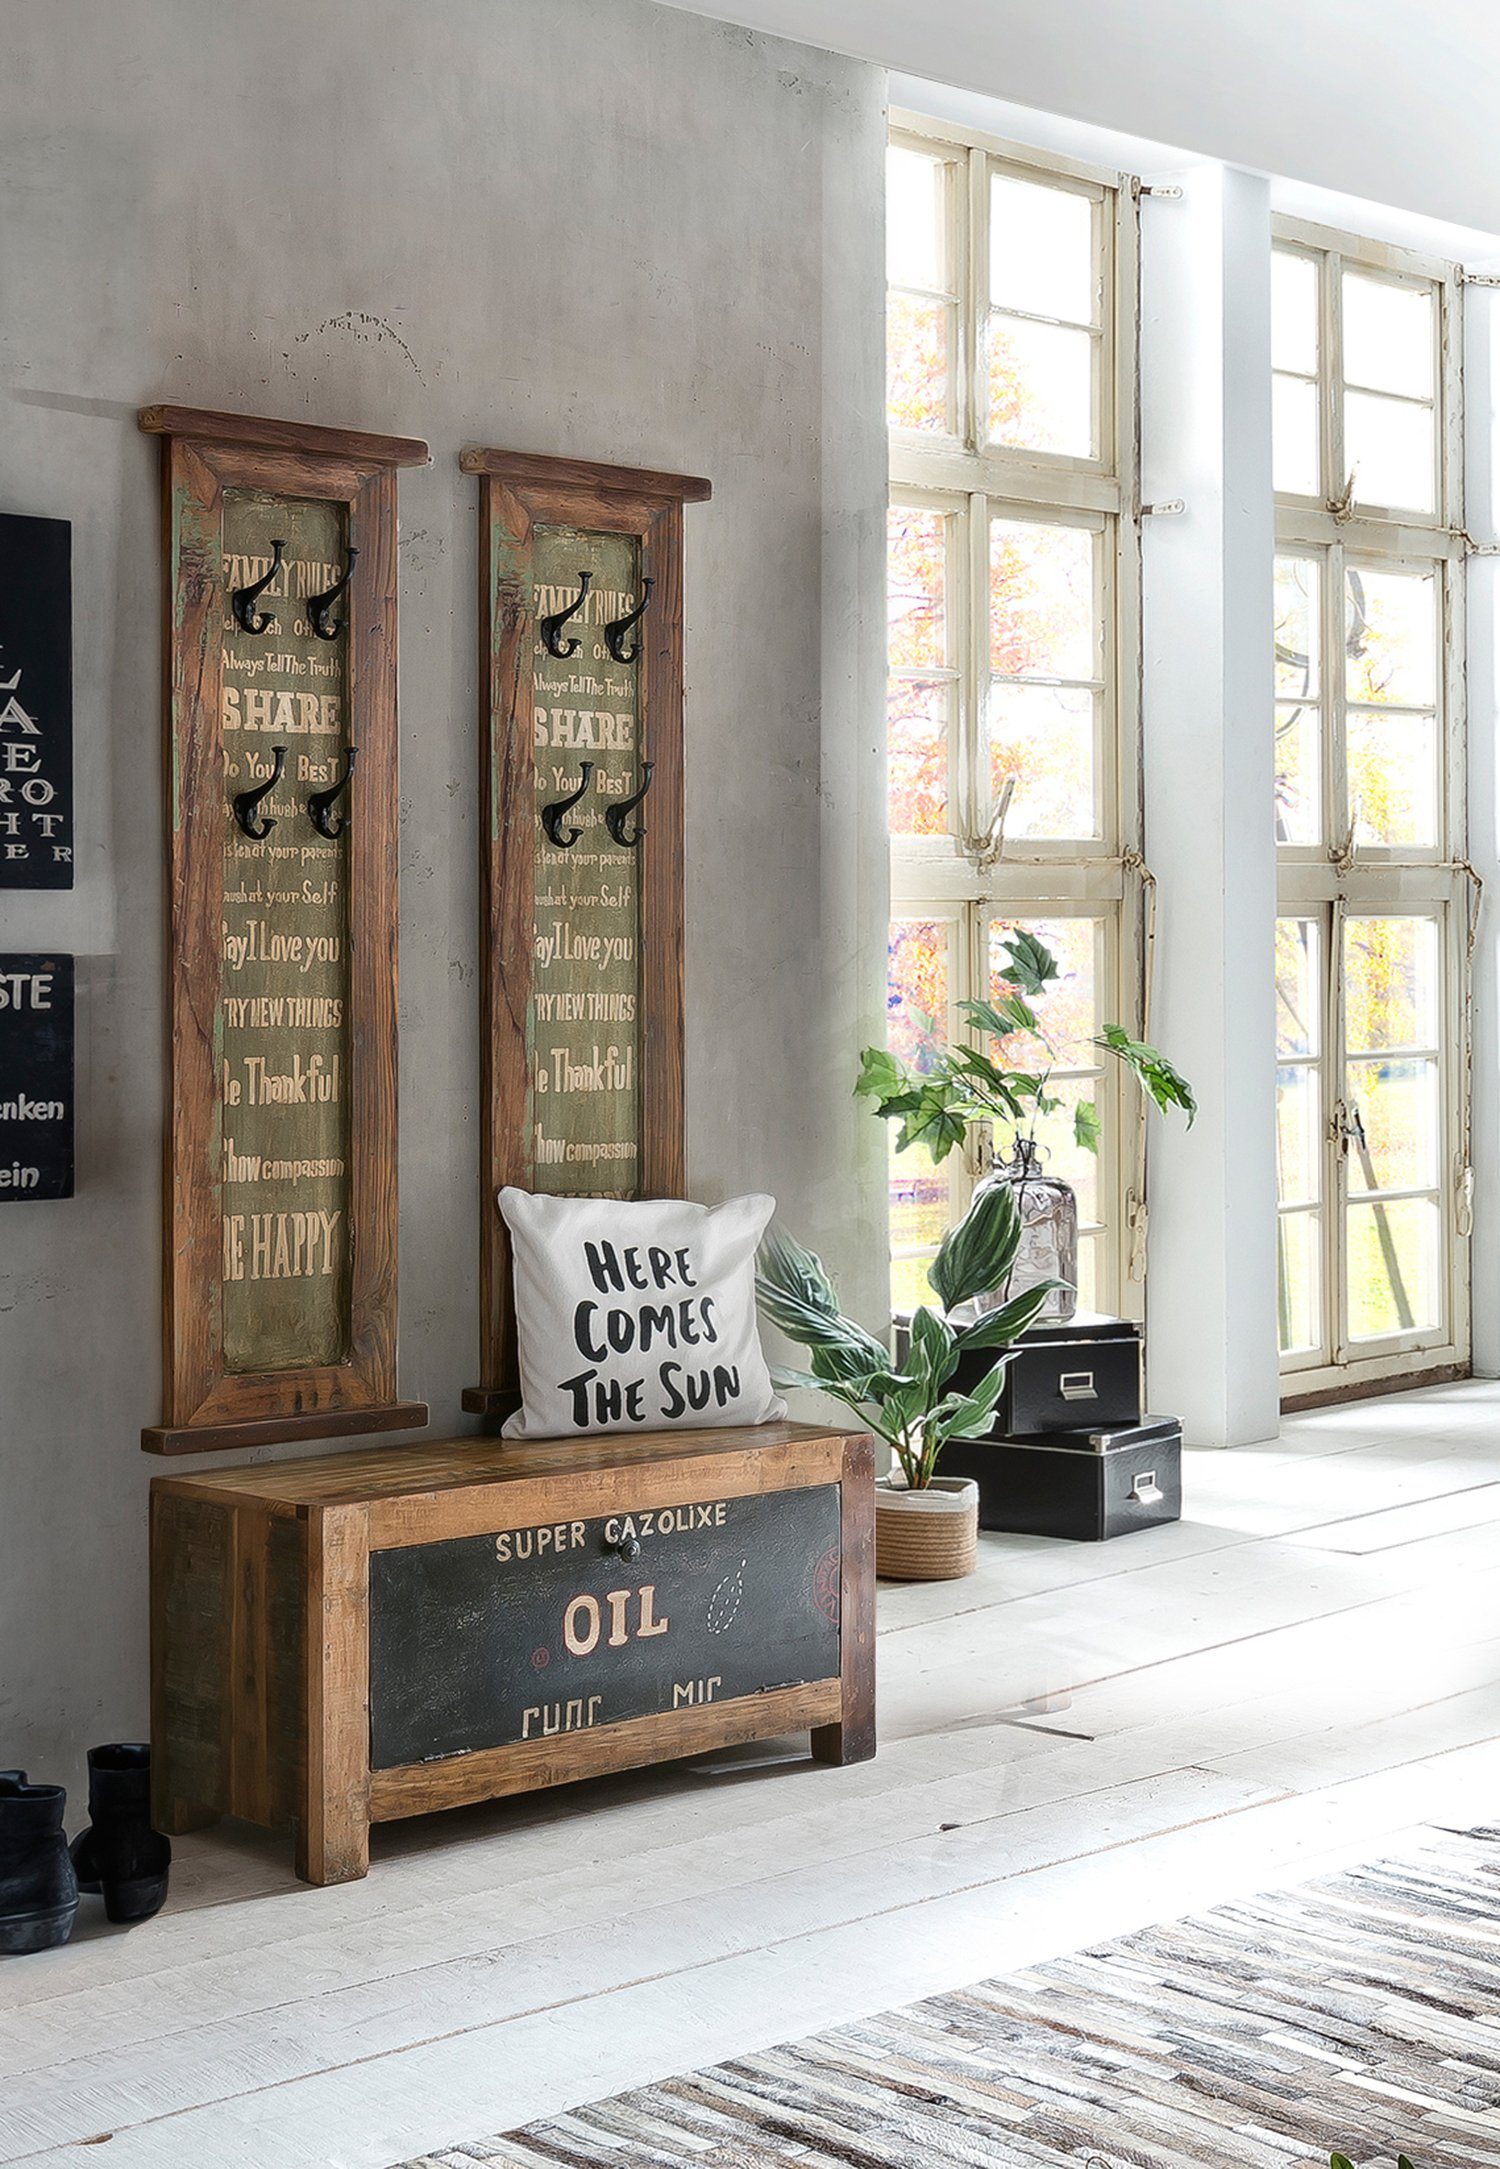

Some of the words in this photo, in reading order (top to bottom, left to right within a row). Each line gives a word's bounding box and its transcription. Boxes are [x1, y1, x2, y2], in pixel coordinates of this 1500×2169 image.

[223, 687, 341, 734] SHARE
[534, 707, 633, 750] SHARE
[302, 879, 338, 904] Self
[601, 884, 631, 907] Self
[261, 921, 301, 962] Love
[300, 937, 339, 972] you
[534, 923, 553, 968] ay
[565, 922, 600, 960] Love
[598, 937, 632, 971] you
[251, 998, 283, 1027] NEW
[287, 998, 343, 1028] THINGS
[556, 993, 585, 1021] NEW
[587, 994, 636, 1022] THINGS
[0, 1093, 64, 1120] nken
[224, 1137, 261, 1183] how
[262, 1158, 345, 1187] compassion
[251, 1210, 341, 1280] HAPPY
[584, 1240, 697, 1294] HERE
[574, 1296, 718, 1363] COMES
[557, 1368, 646, 1427] THE
[659, 1361, 740, 1419] SUN
[495, 1521, 586, 1562] SUPER
[564, 1585, 669, 1656] OIL
